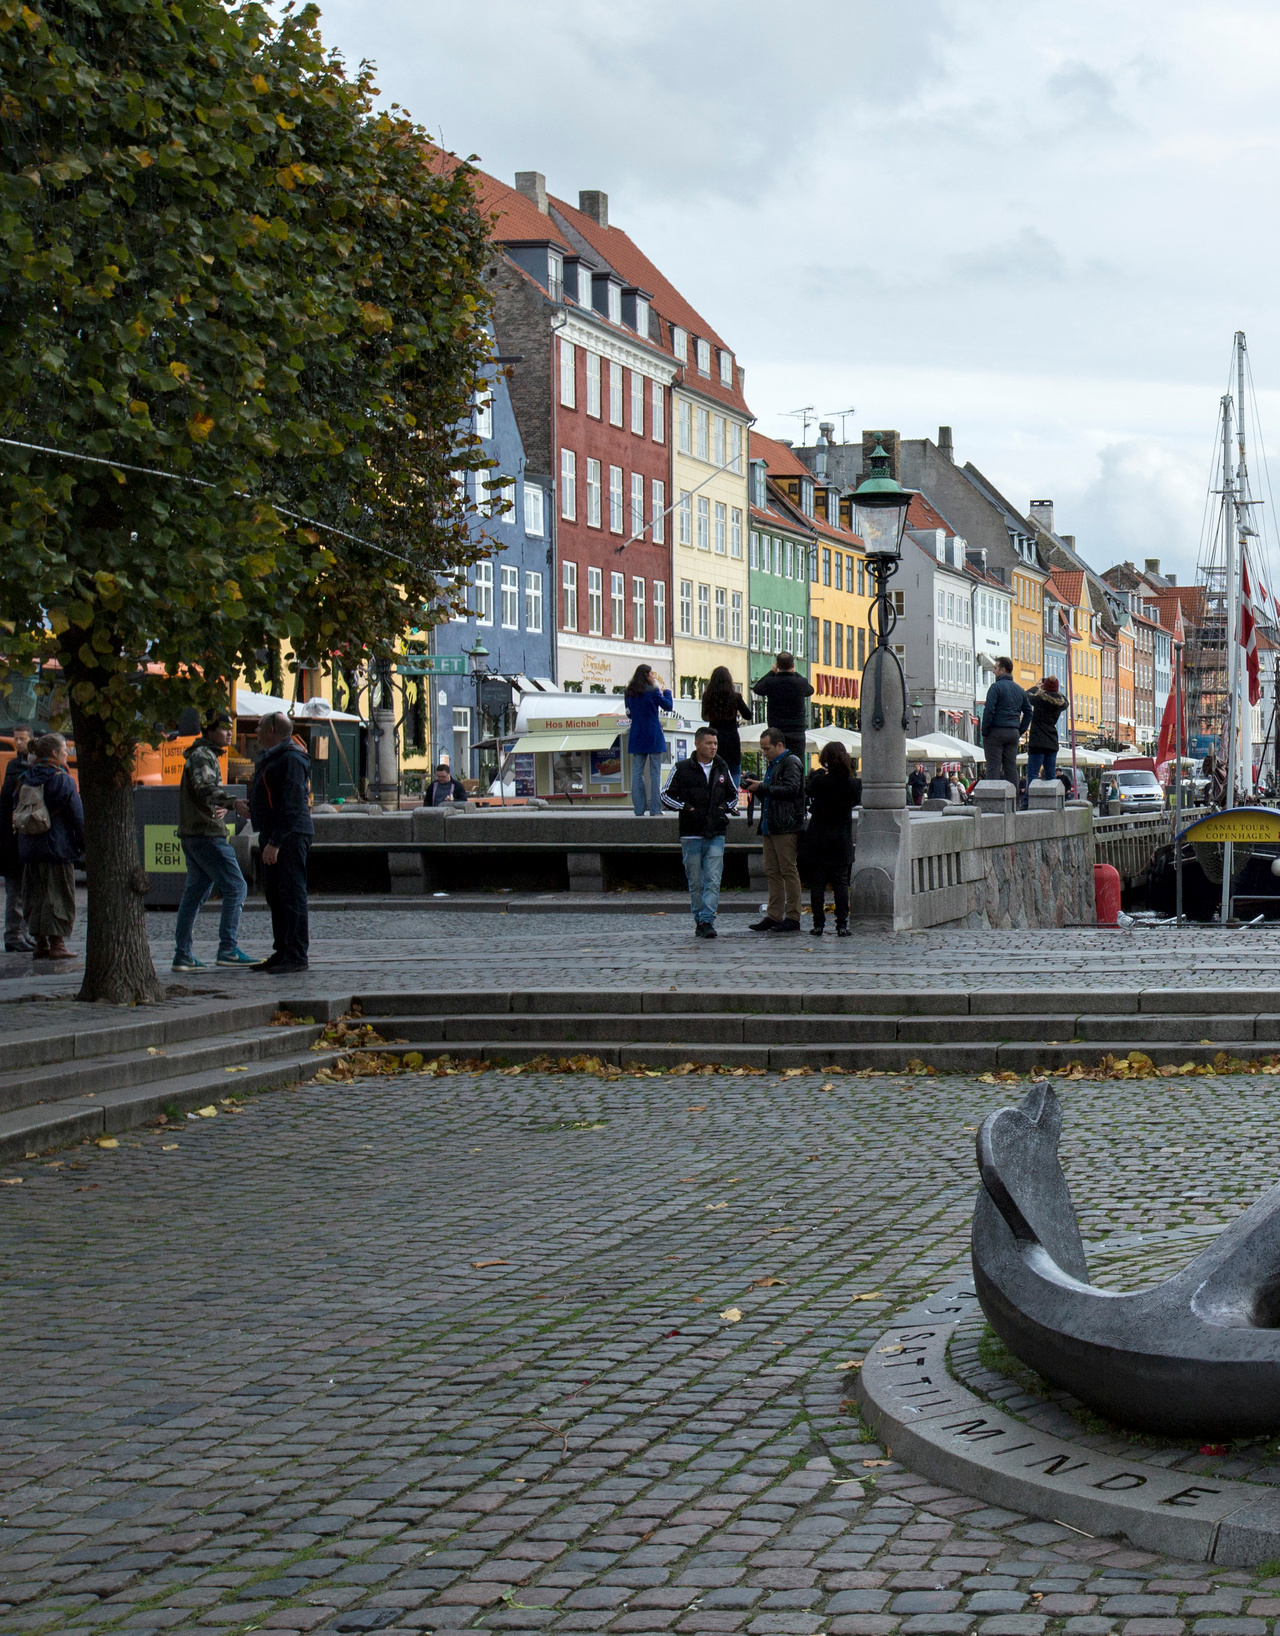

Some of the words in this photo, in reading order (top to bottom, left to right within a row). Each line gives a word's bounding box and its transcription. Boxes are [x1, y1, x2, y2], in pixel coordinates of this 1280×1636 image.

[816, 673, 859, 700] NYHAVN
[545, 720, 563, 729] Hos
[565, 719, 600, 728] Michael
[1206, 823, 1238, 832] CANAL
[1240, 823, 1270, 831] TOURS
[1205, 832, 1271, 840] COPENHAGEN
[155, 842, 181, 852] REN
[155, 856, 181, 865] KBH
[940, 1418, 1222, 1507] MINDE
